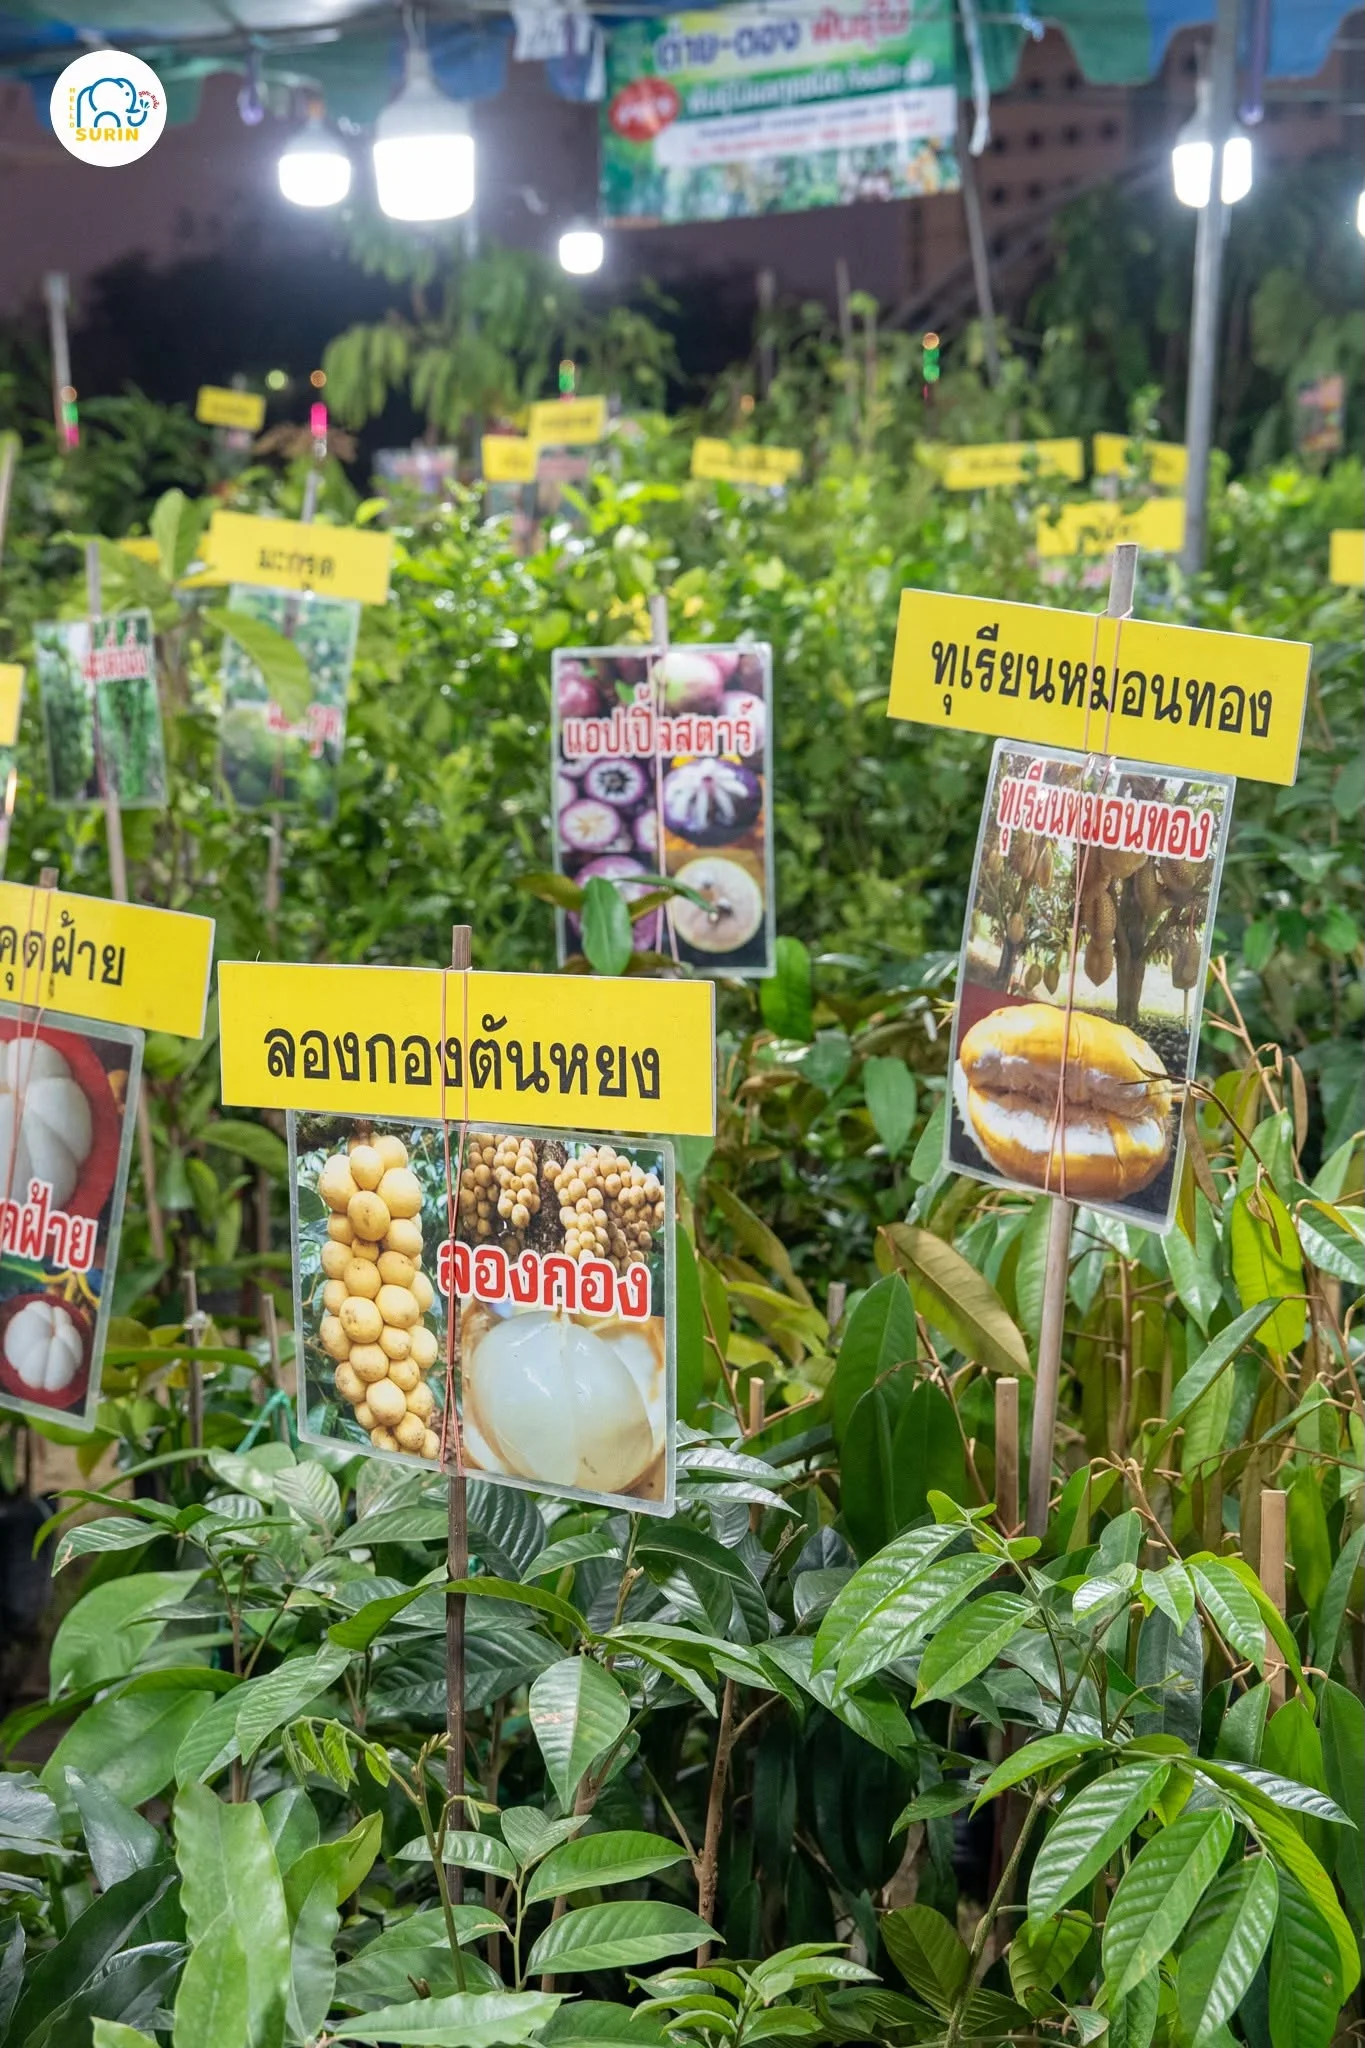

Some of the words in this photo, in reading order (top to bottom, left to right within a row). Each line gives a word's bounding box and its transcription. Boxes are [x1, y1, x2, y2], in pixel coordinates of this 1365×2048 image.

[932, 623, 1273, 738] ทุเรียนหมอนทอง
[999, 761, 1212, 860] ทุเรียนหมอนทอง
[265, 1014, 661, 1099] ลองกองตันหยง
[438, 1239, 651, 1321] ลองกอง
